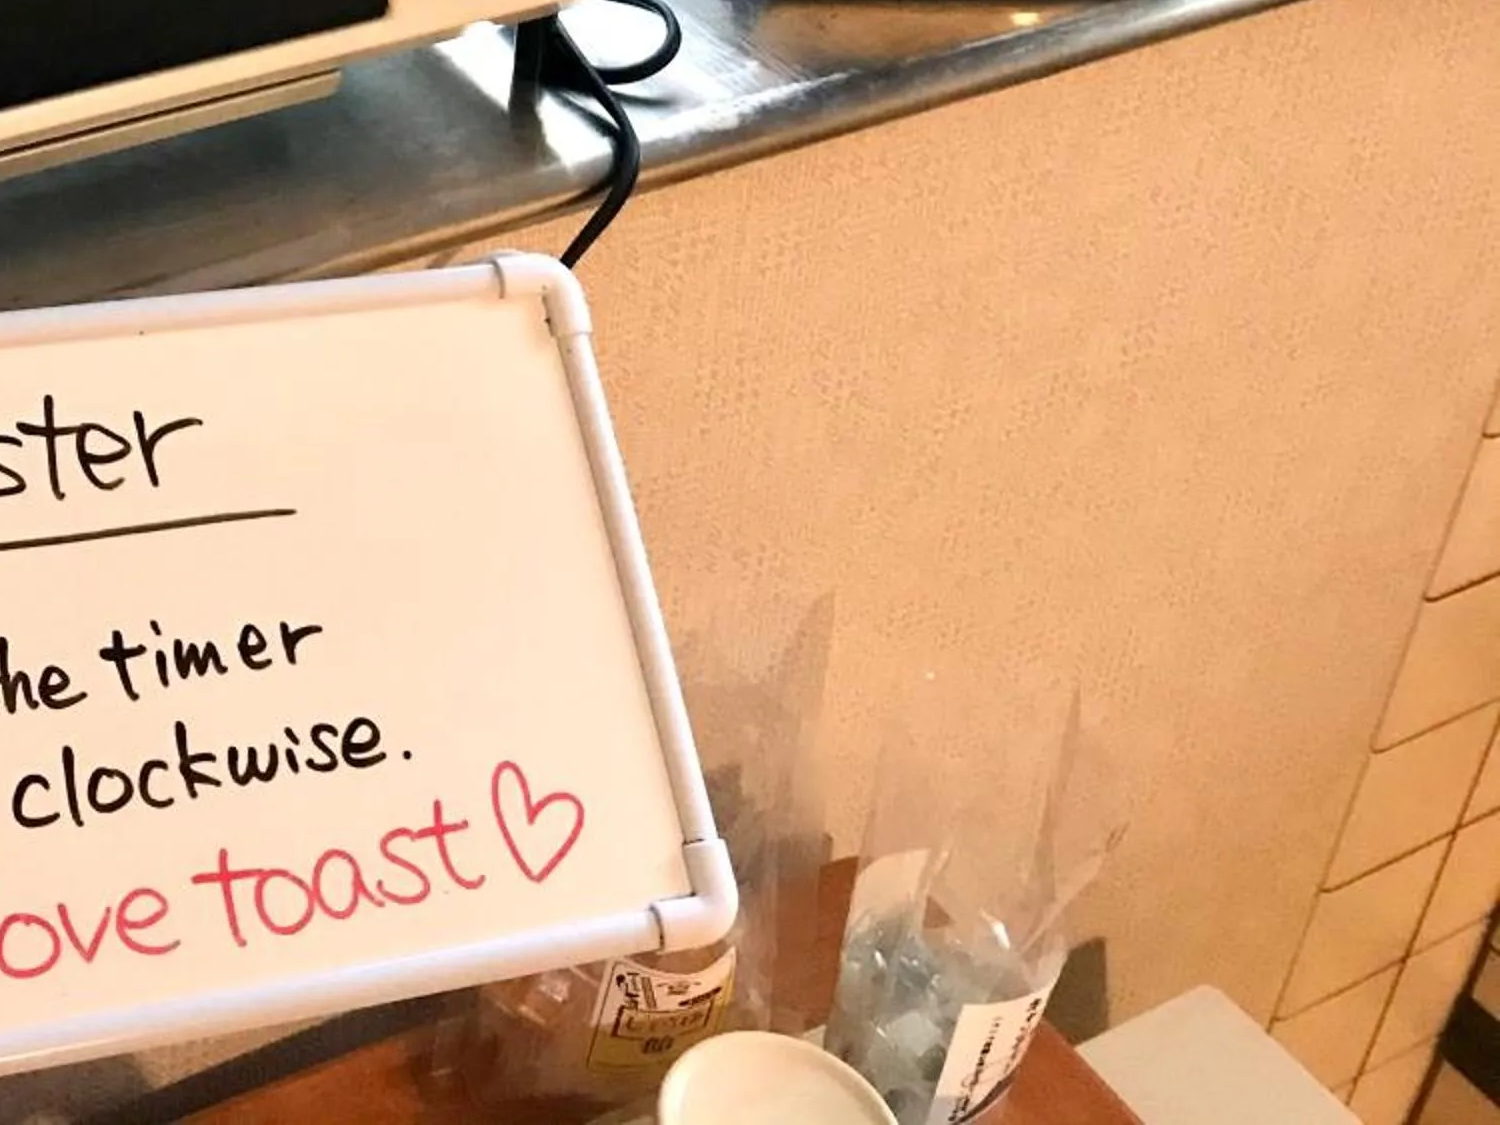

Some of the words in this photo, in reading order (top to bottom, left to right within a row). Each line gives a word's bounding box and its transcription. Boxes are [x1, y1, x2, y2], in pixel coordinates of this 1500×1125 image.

[98, 619, 323, 702] timer
[10, 716, 415, 829] clockwise.
[192, 799, 485, 948] toast
